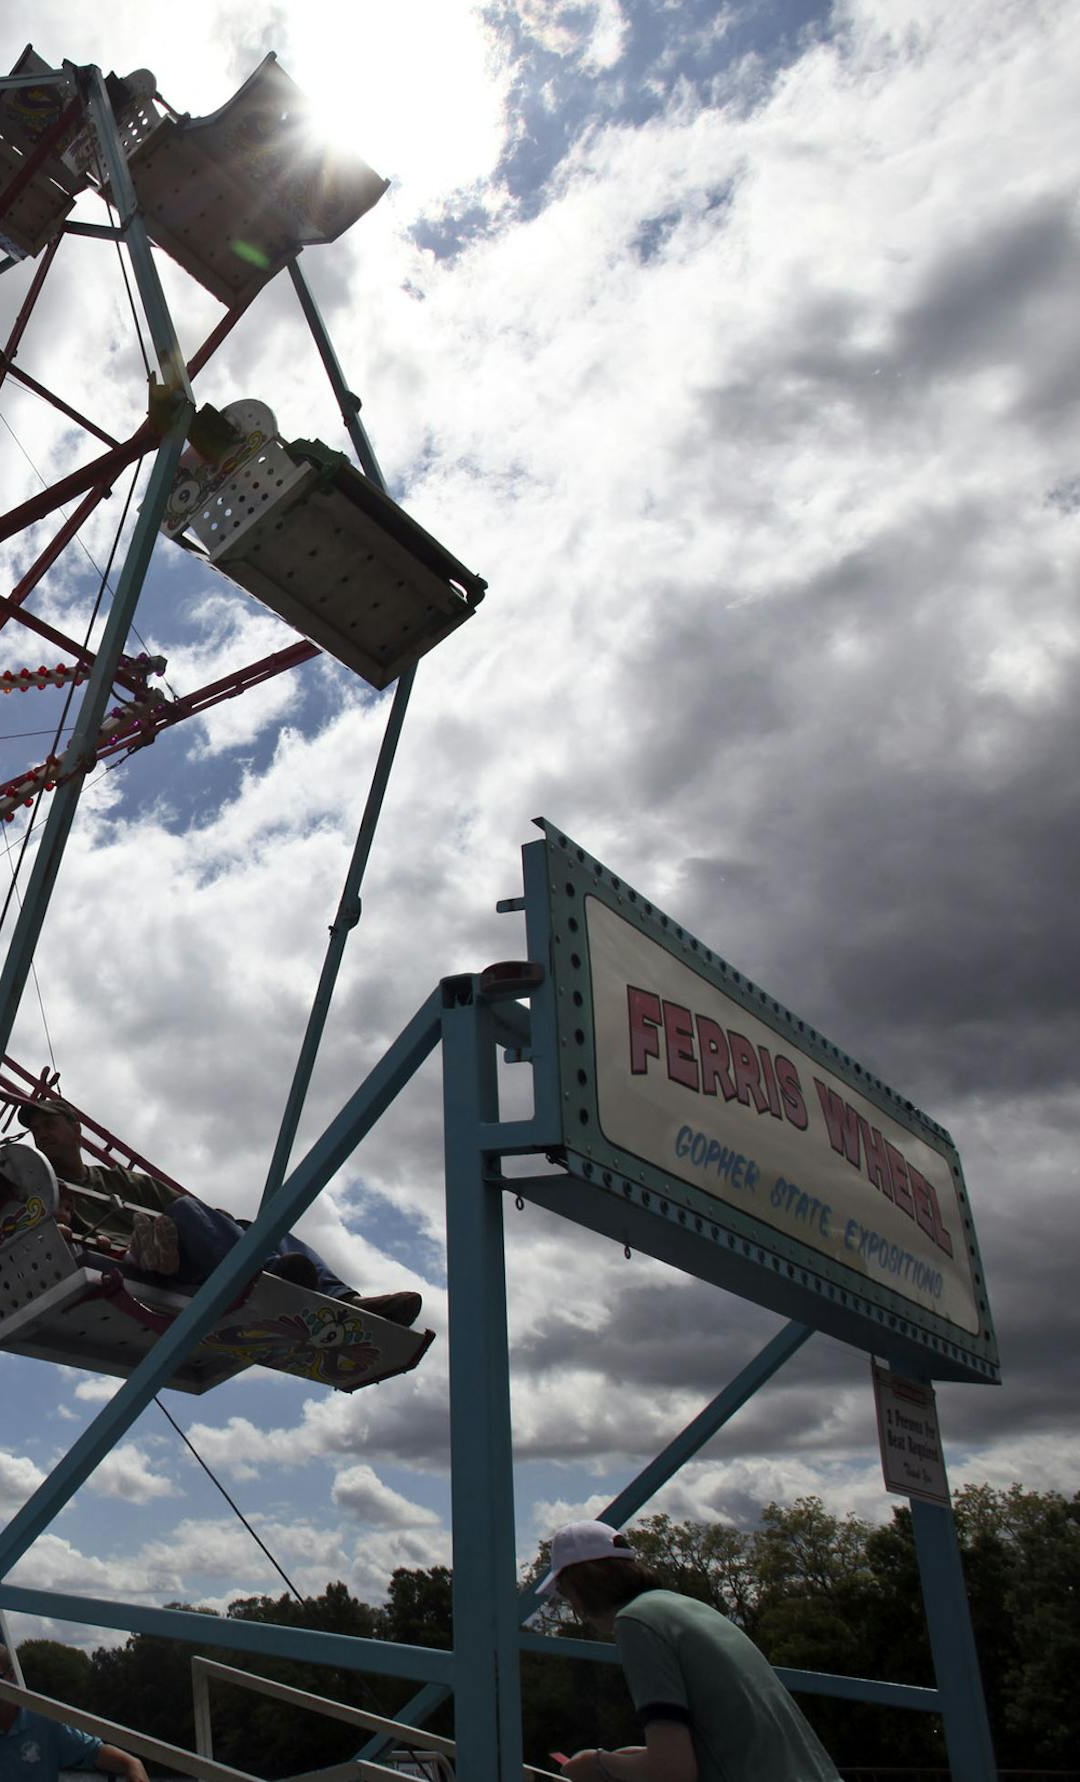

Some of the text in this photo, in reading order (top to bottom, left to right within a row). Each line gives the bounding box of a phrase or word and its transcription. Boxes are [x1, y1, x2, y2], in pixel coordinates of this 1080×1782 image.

[626, 984, 954, 1259] FERRIS WHEEL
[675, 1125, 944, 1299] GOPHER STATE EXPOSITIONS
